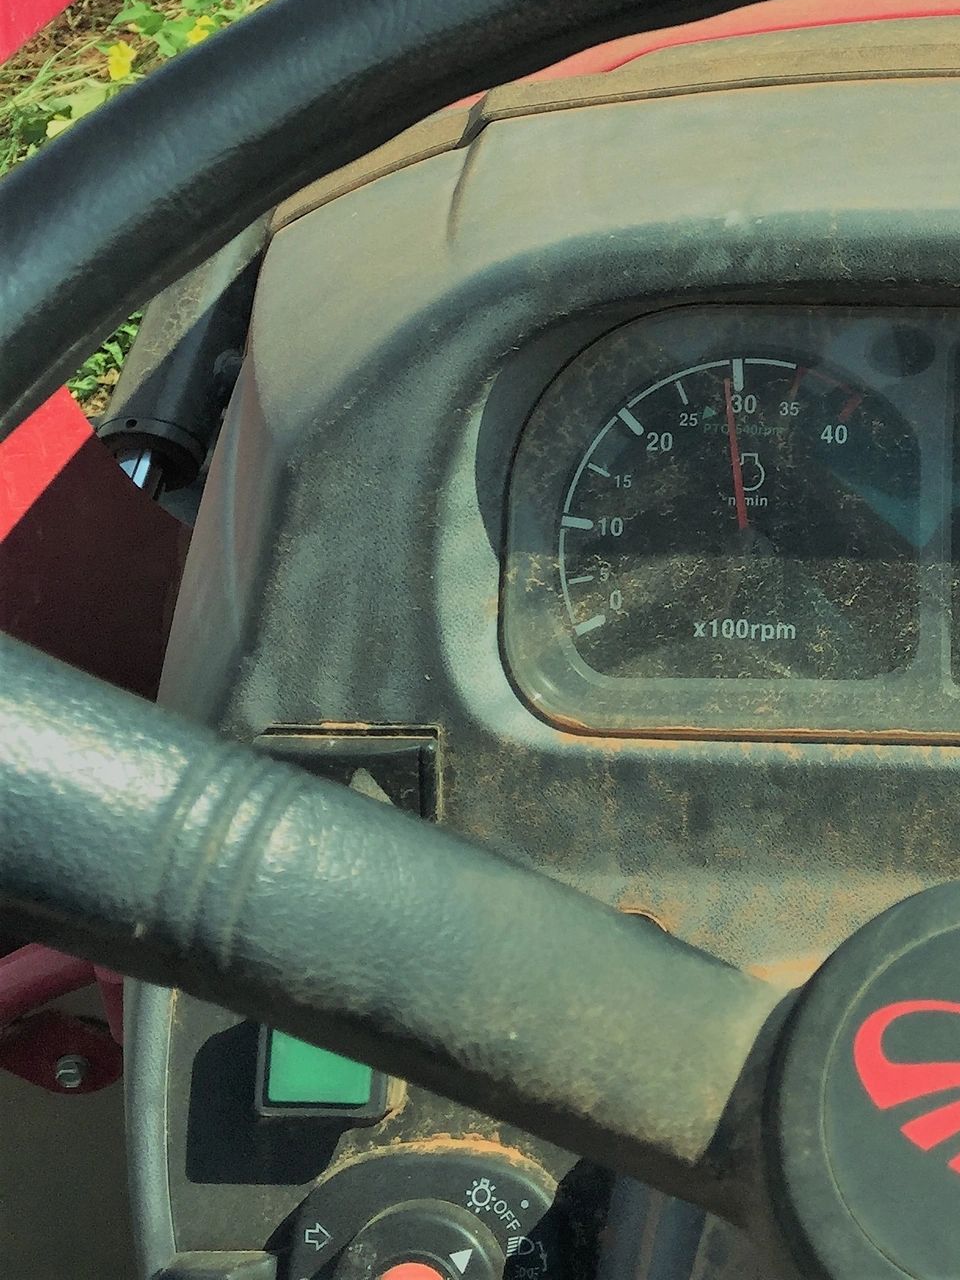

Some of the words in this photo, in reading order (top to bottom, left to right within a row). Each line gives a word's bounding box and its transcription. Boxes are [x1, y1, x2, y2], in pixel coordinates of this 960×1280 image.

[732, 395, 757, 414] 30
[779, 401, 800, 416] 35
[679, 412, 698, 427] 25
[646, 432, 673, 451] 20
[820, 424, 848, 444] 40
[614, 475, 632, 488] 15
[728, 495, 768, 507] nmin
[599, 517, 623, 537] 10
[609, 589, 622, 610] 0
[693, 618, 796, 642] x100rpm
[493, 1199, 522, 1231] OFF
